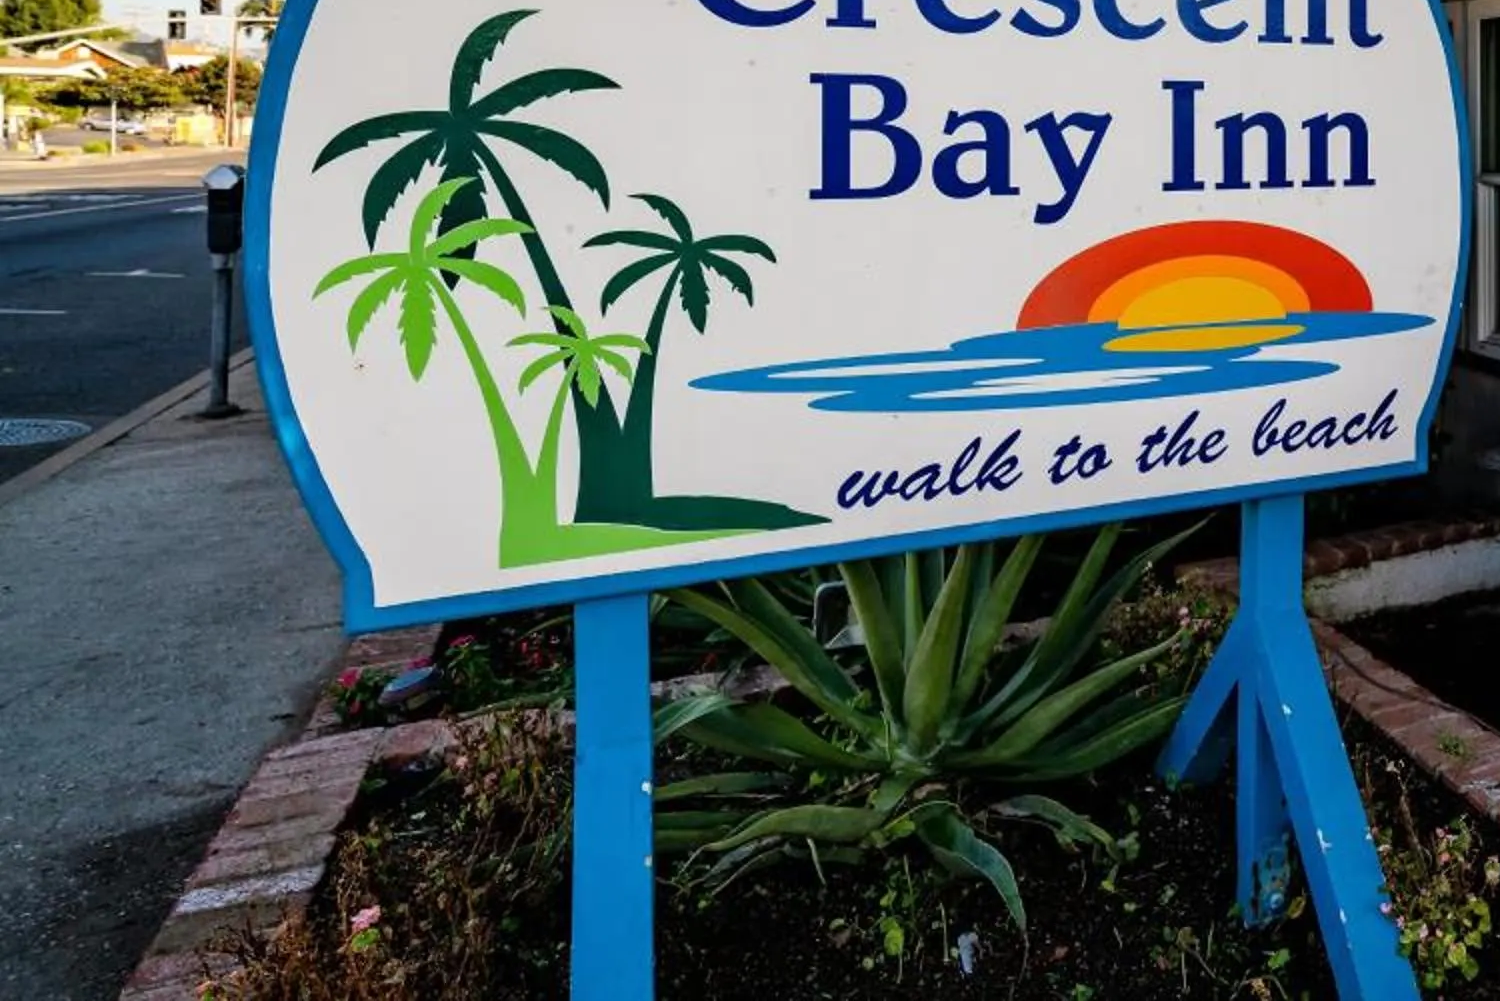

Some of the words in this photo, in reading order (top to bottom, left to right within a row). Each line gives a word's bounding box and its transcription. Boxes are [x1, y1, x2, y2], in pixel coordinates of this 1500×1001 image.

[808, 71, 1114, 225] Bay
[1160, 79, 1377, 192] Inn
[837, 429, 1023, 510] walk
[1047, 434, 1113, 485] to
[1135, 410, 1230, 474] the
[1251, 388, 1399, 457] beach
